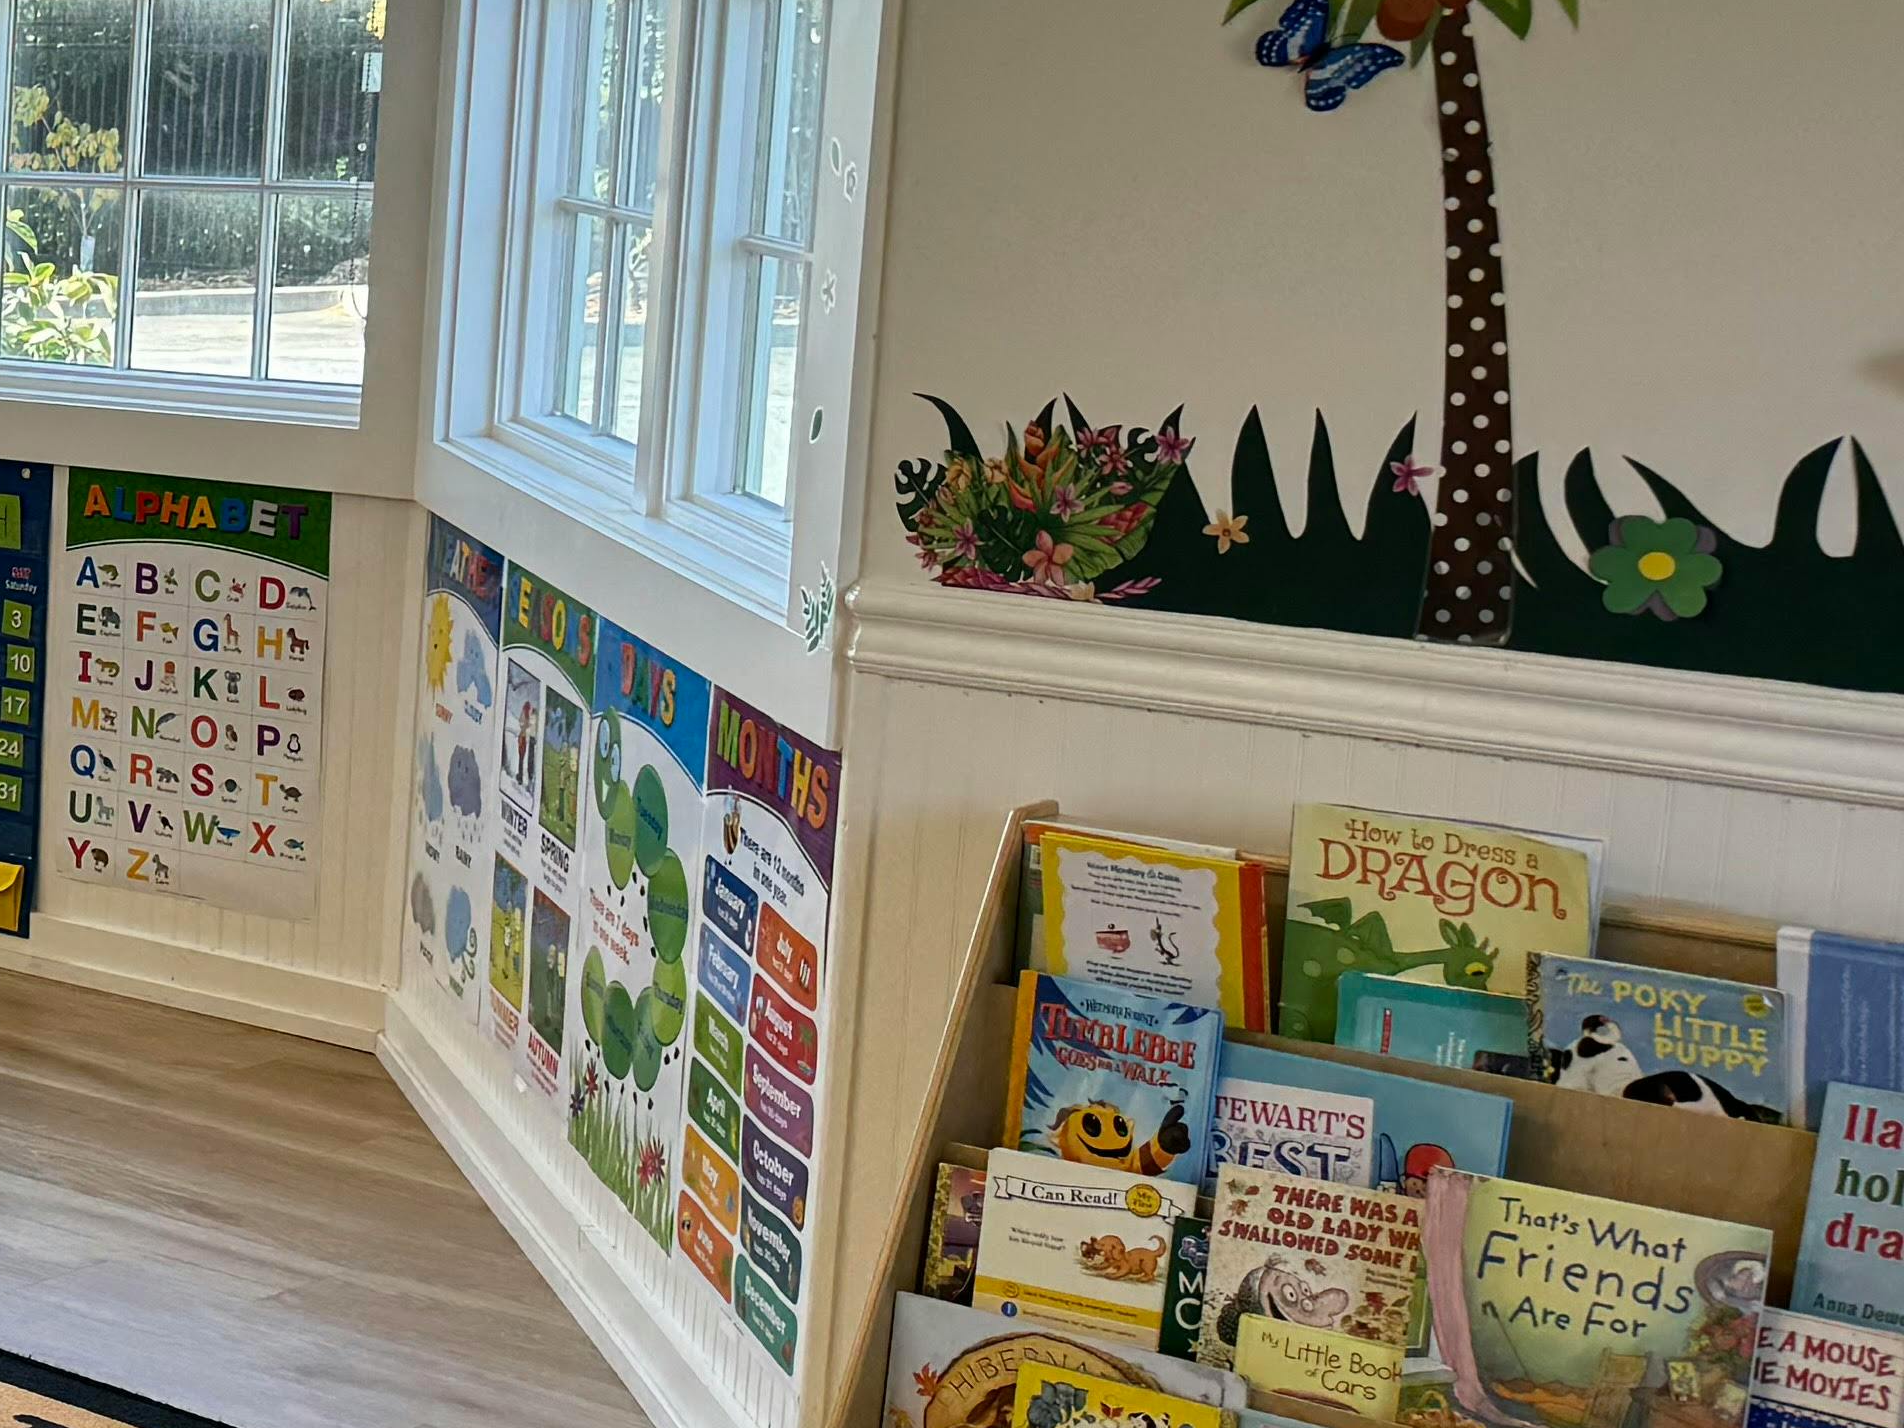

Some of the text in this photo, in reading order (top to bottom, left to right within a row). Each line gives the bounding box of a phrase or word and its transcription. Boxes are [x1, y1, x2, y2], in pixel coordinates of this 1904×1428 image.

[84, 484, 308, 540] ALPHABET
[5, 580, 37, 595] Saturday
[621, 642, 676, 726] DAYS
[717, 700, 830, 829] MONTHS
[541, 836, 570, 873] SPRING
[1345, 819, 1539, 870] How to Dress a
[1566, 973, 1708, 1015] The POKY
[1654, 1012, 1769, 1052] LITTLE
[1655, 1037, 1770, 1077] PUPPY
[752, 1064, 802, 1119] September
[1215, 1095, 1365, 1140] TEWART'S
[1844, 1104, 1904, 1149] lla
[753, 1140, 794, 1186] October
[1207, 1129, 1352, 1187] BEST
[1020, 1182, 1118, 1205] I Can Read!
[1136, 1191, 1154, 1203] My
[1833, 1158, 1904, 1206] hol
[1267, 1207, 1420, 1250] OLD LADY WH
[1273, 1185, 1419, 1228] THERE WAS A
[1498, 1196, 1689, 1263] That's What
[1218, 1220, 1403, 1268] SWALLOWED SOME
[1825, 1212, 1904, 1260] dra
[1477, 1229, 1695, 1315] Friends
[744, 1275, 786, 1335] December
[1508, 1295, 1648, 1340] Are For
[1813, 1293, 1857, 1316] Anna
[949, 1347, 1091, 1399] HIBERNA
[1262, 1331, 1279, 1348] My
[1284, 1337, 1342, 1369] Little
[1778, 1330, 1896, 1377] A MOUSE
[1321, 1371, 1377, 1400] Cars
[1786, 1364, 1891, 1411] MOVIES
